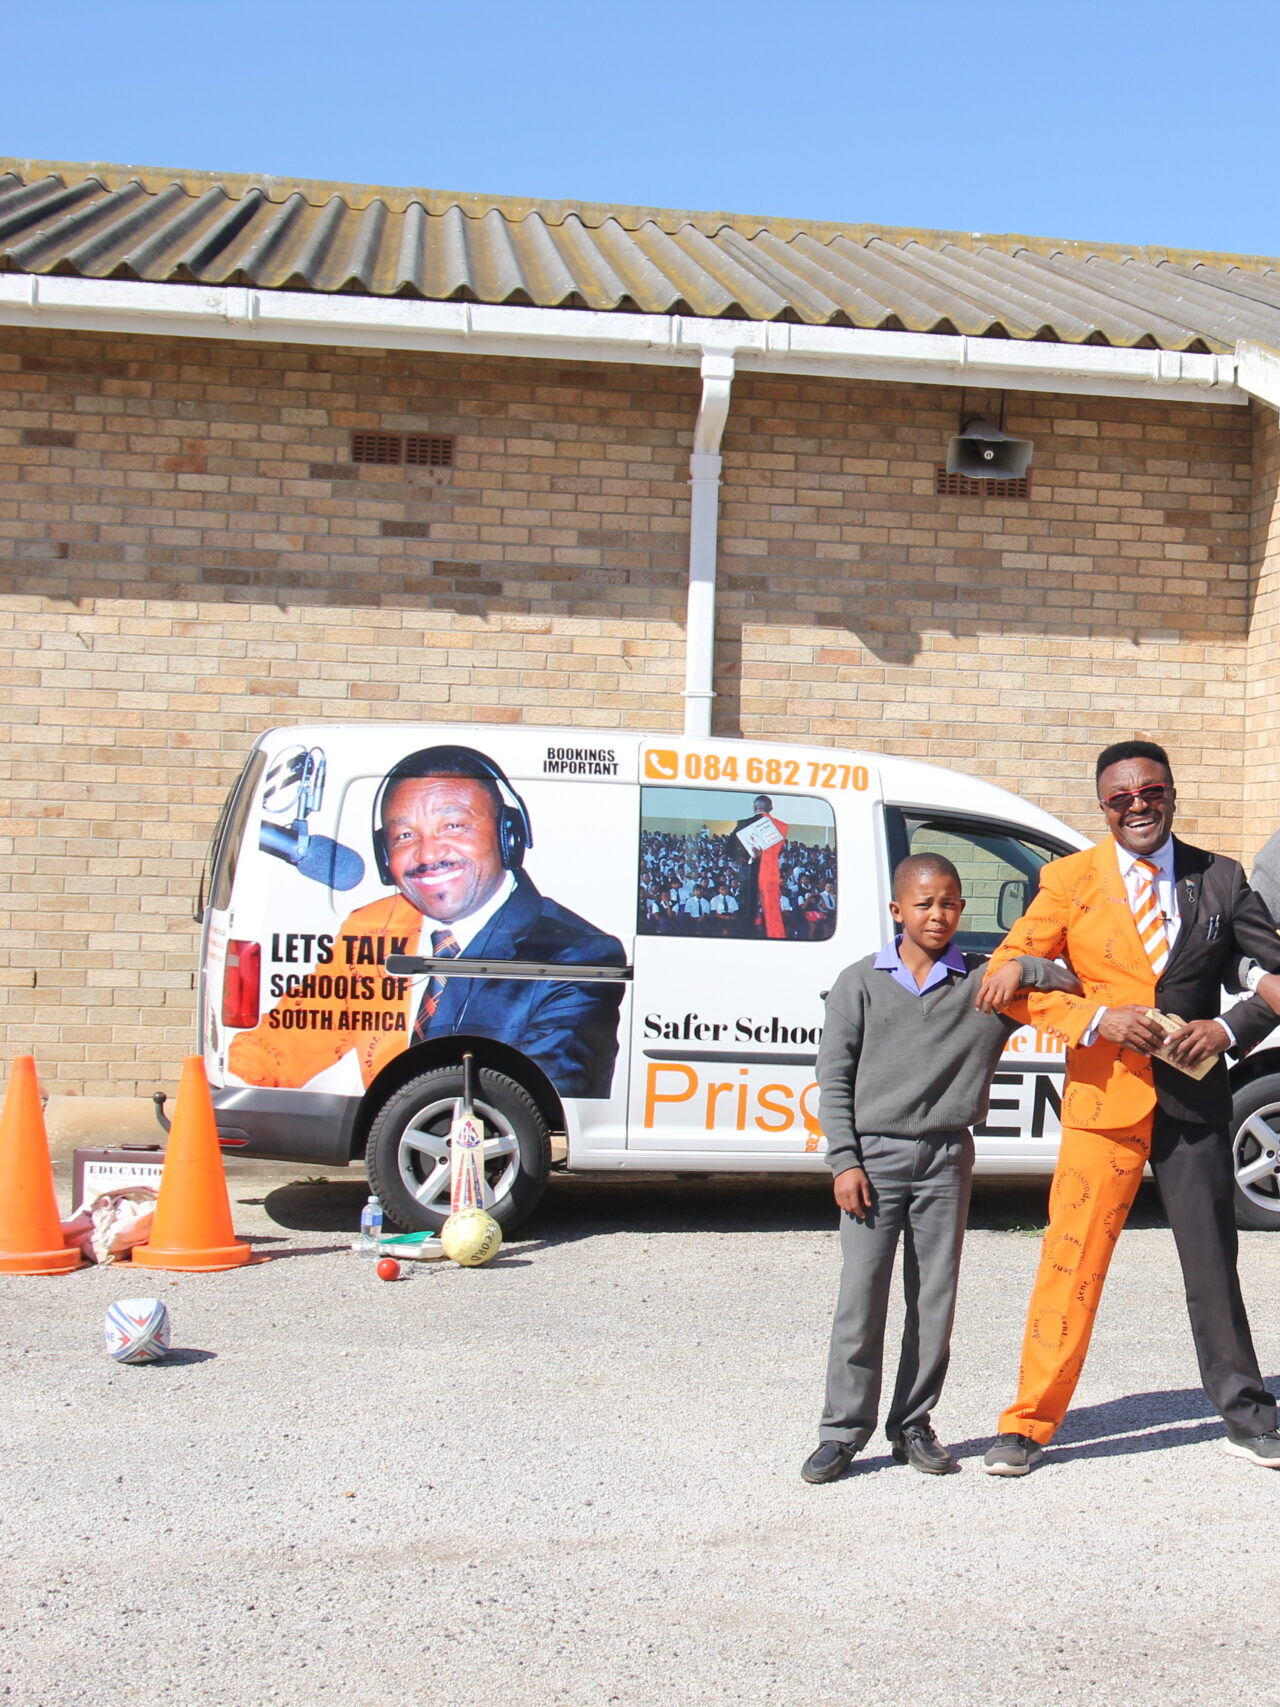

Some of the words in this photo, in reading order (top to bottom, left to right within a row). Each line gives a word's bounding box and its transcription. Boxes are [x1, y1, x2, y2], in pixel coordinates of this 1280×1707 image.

[543, 760, 619, 776] IMPORTANT
[547, 747, 615, 762] BOOKINGS
[685, 753, 739, 782] 084
[746, 757, 800, 786] 682
[807, 762, 869, 791] 7270
[271, 933, 334, 964] LETS
[270, 974, 375, 1000] SCHOOLS
[381, 976, 408, 1001] OF
[268, 1009, 333, 1030] SOUTH
[338, 1011, 407, 1032] AFRICA
[644, 1013, 728, 1041] Safer
